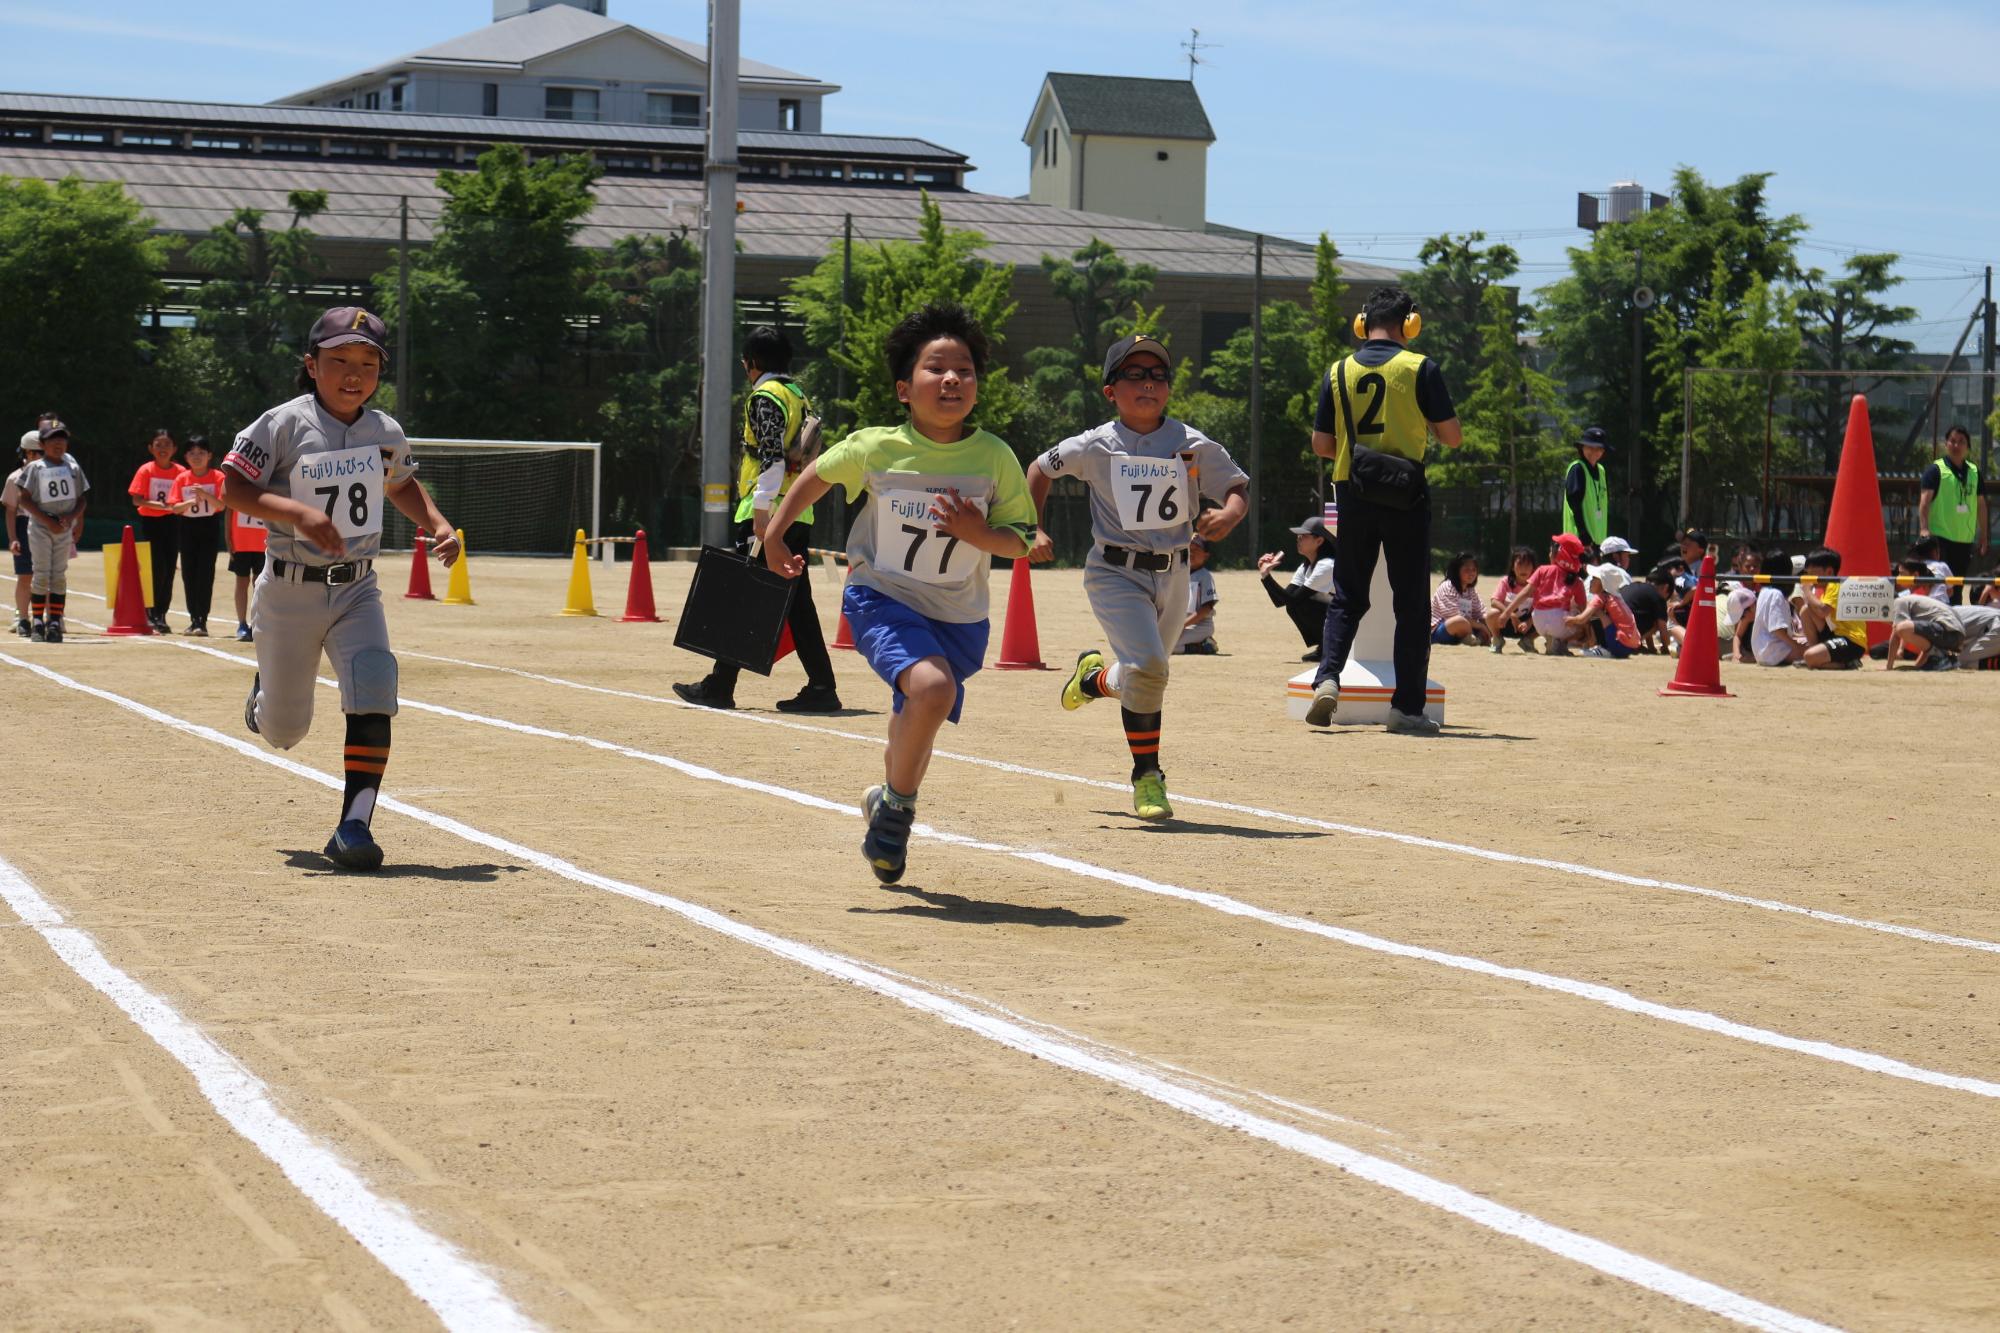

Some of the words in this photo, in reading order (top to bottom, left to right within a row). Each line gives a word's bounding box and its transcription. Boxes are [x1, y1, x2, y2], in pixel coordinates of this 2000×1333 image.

[351, 310, 368, 330] F
[1356, 372, 1386, 435] 2
[1120, 464, 1180, 479] Fujiりんぴっ
[48, 479, 70, 498] 80
[315, 482, 368, 527] 78
[1130, 484, 1178, 523] 76
[901, 523, 960, 575] 77
[1845, 605, 1876, 615] STOP
